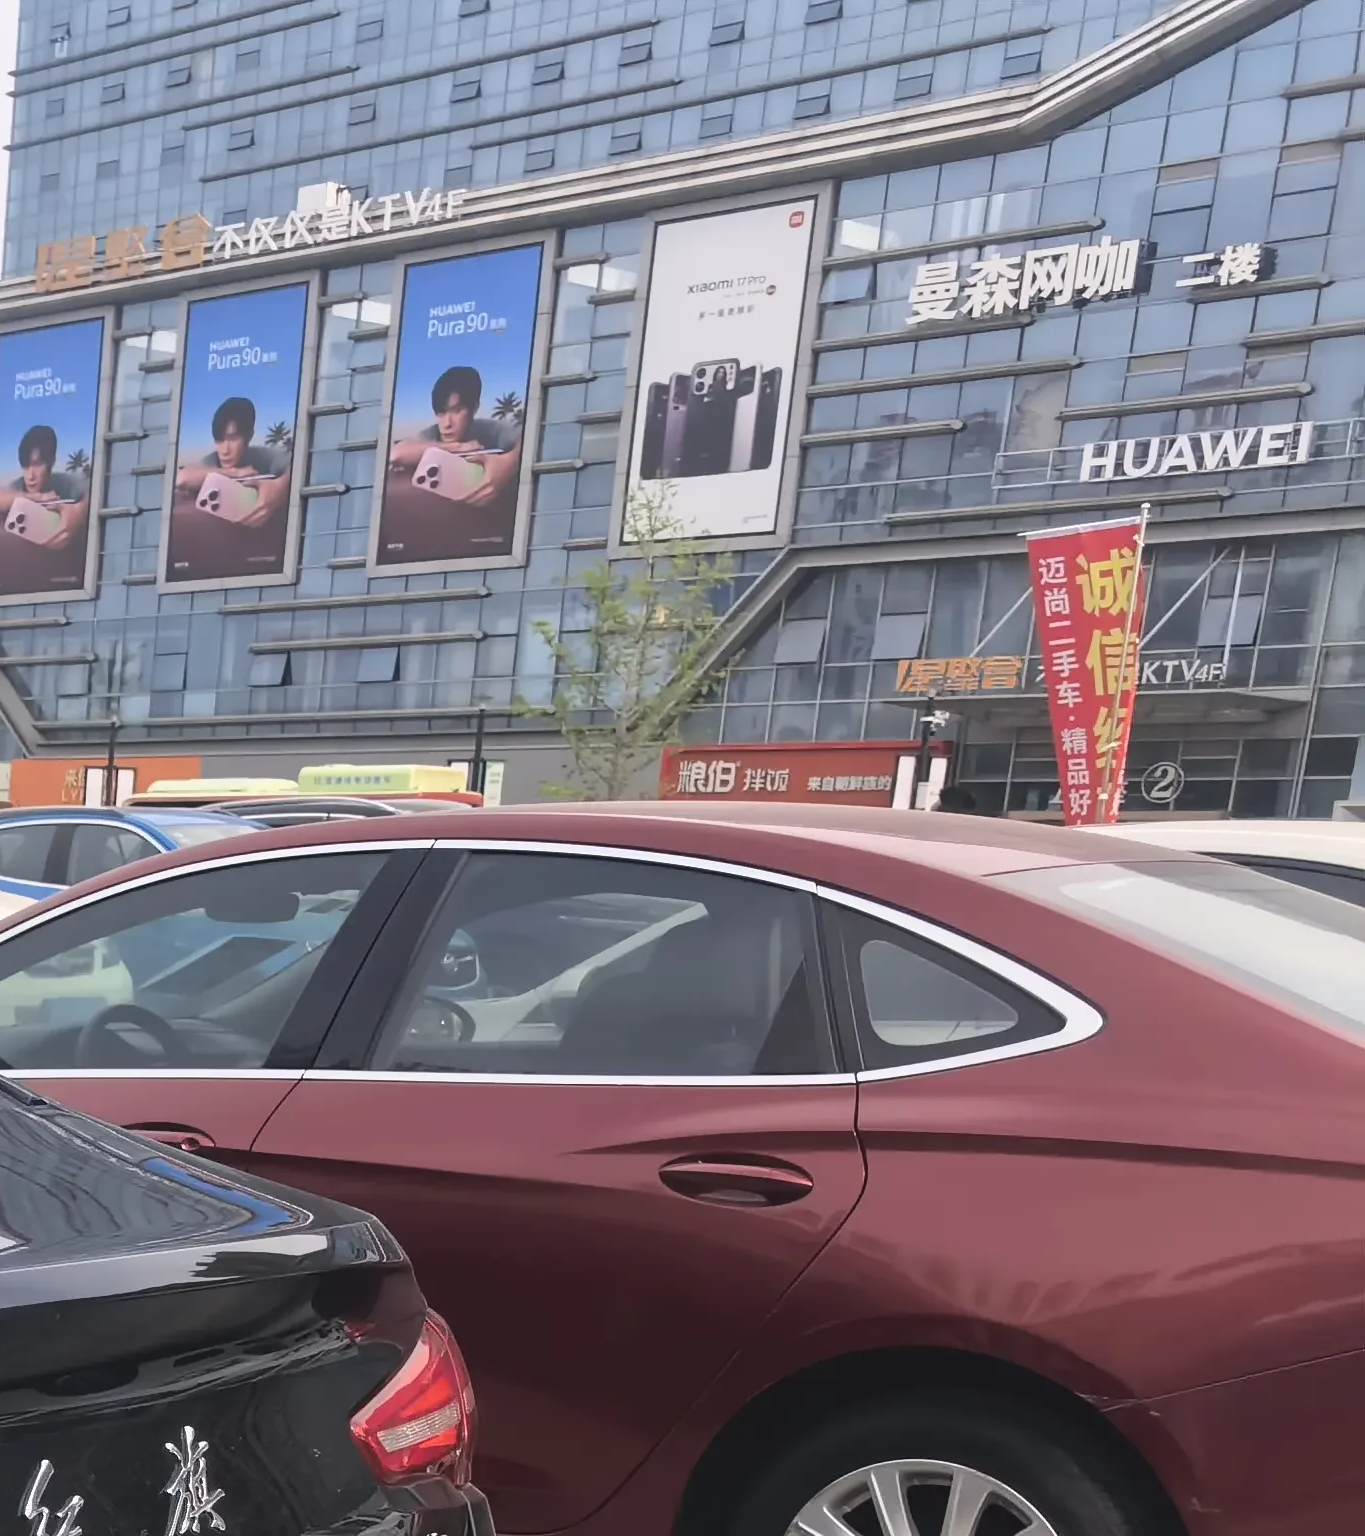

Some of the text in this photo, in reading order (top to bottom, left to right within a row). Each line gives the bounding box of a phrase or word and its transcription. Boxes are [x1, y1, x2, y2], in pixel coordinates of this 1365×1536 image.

[429, 301, 476, 318] HUAWEI
[905, 236, 1262, 325] 曼森网咖 二楼
[1080, 421, 1315, 483] HUAWEI
[1038, 556, 1092, 826] 迈尚二手车·精品好
[742, 768, 790, 792] 拌饭
